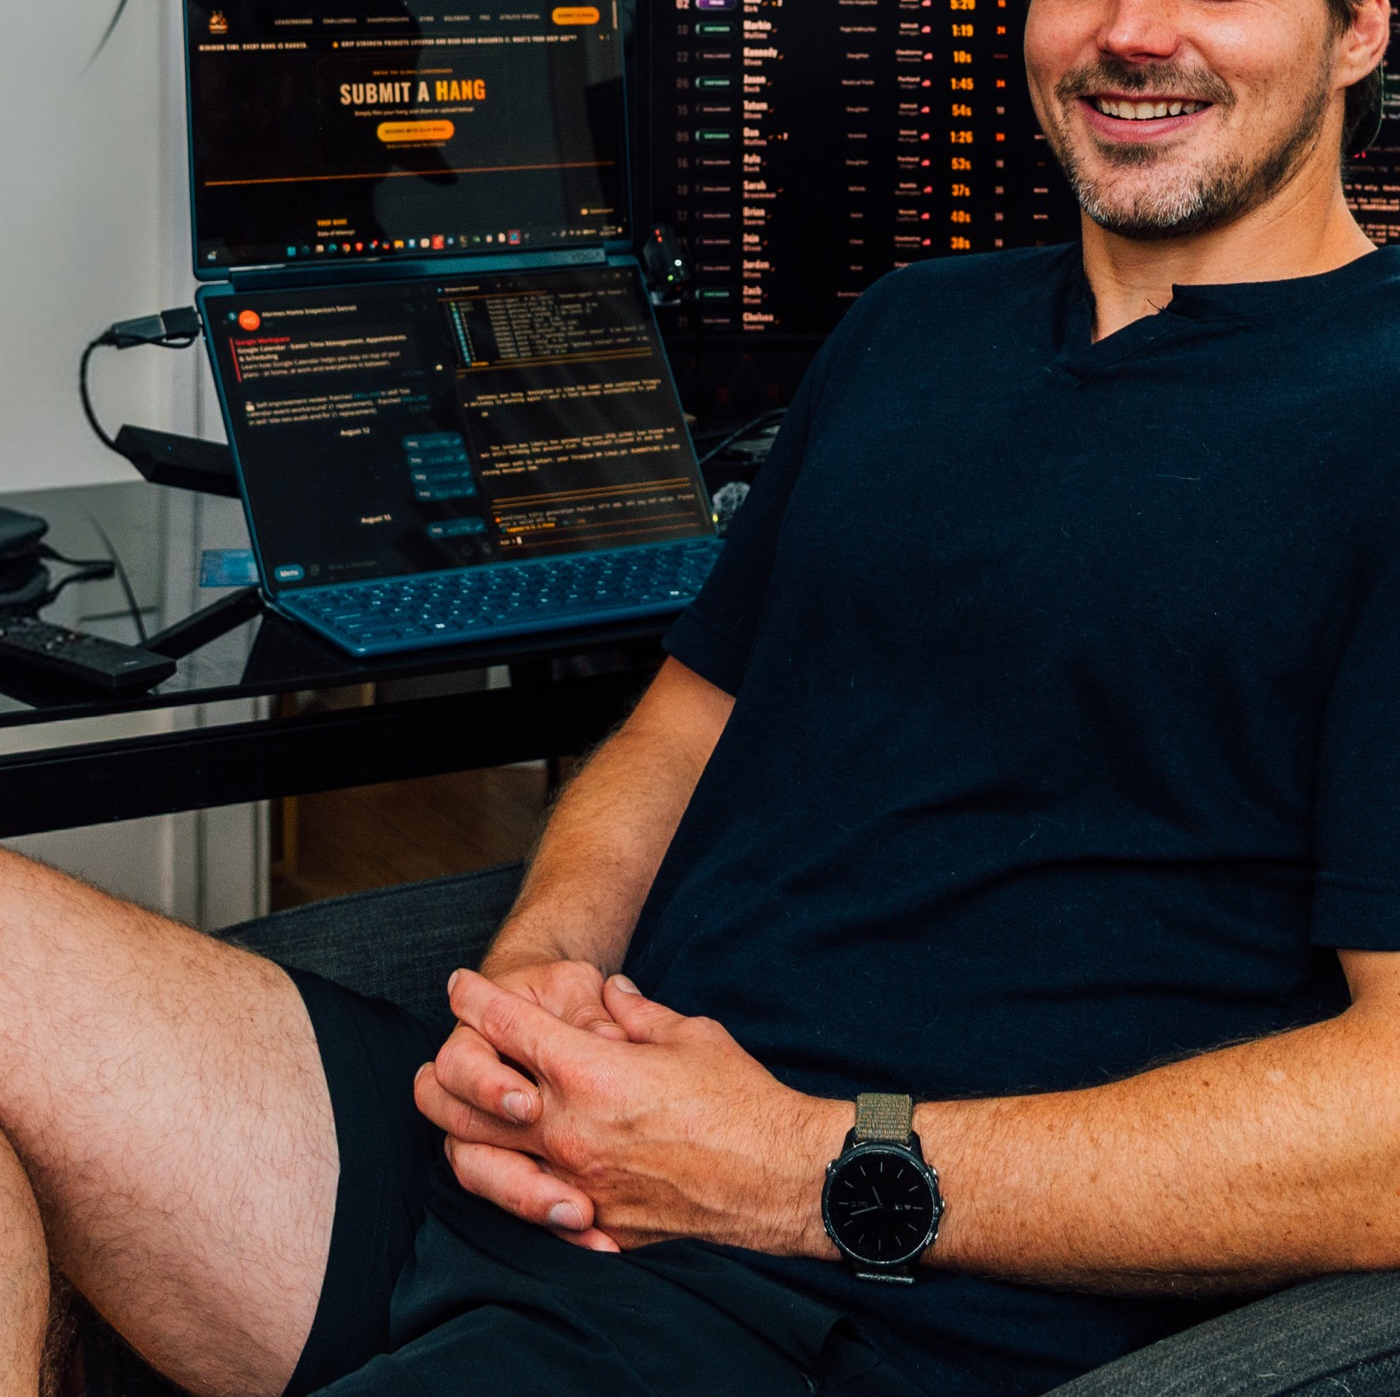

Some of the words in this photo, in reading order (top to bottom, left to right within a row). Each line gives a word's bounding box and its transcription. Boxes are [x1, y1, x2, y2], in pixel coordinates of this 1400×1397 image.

[340, 81, 411, 105] SUBMIT
[417, 81, 430, 102] A
[435, 78, 486, 102] HANG
